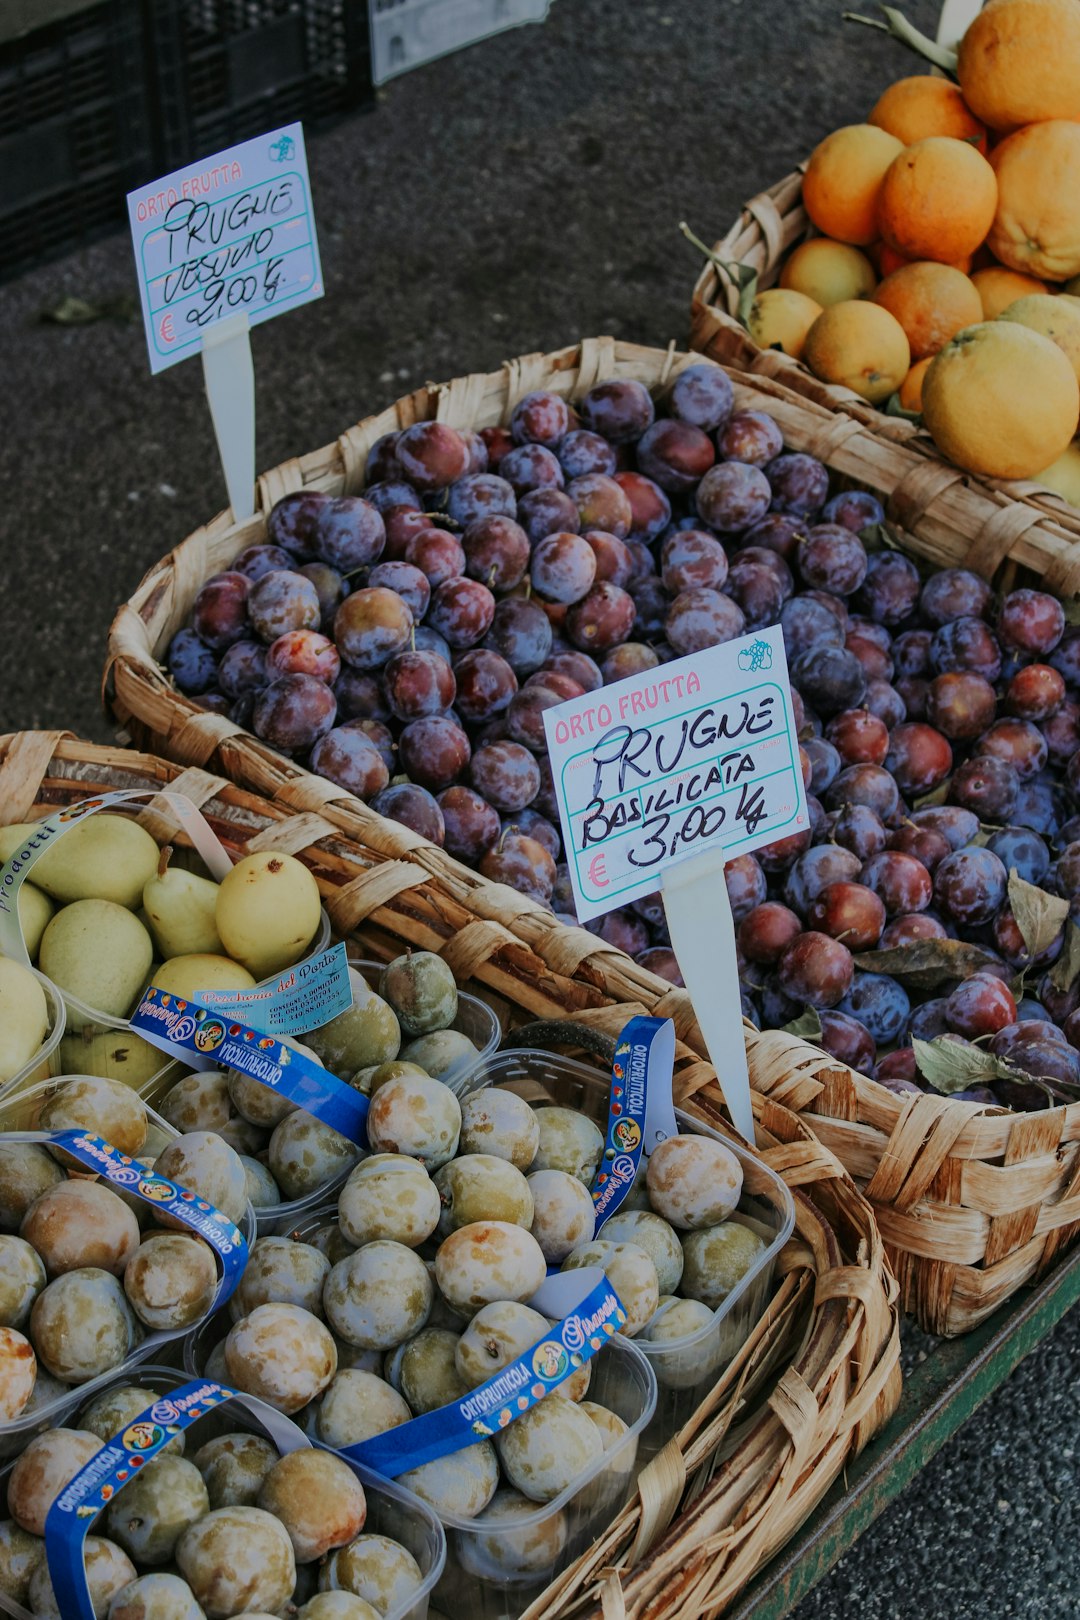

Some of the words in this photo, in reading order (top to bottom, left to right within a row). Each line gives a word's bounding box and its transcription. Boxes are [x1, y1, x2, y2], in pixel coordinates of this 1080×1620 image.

[137, 188, 177, 222] ORTO
[181, 161, 242, 200] FRUTTA
[164, 227, 274, 304] VESUVIO
[160, 314, 176, 343] €
[186, 276, 257, 327] 2,00
[555, 704, 613, 745] ORTO
[618, 671, 701, 720] FRUTTA
[593, 697, 774, 798] PRUGNE
[582, 753, 755, 848] BASILICATA
[588, 853, 610, 888] €
[627, 806, 726, 867] 3,00
[202, 990, 273, 1004] Pescheria
[277, 973, 296, 993] del
[269, 997, 301, 1013] CONSEGNE
[309, 974, 340, 997] DOMICILIO
[218, 1042, 283, 1085] ORTOFRUTTICOLA
[629, 1044, 648, 1115] ORTOFRUTTICOLA
[168, 1200, 233, 1254] ORTOFRUTTICOLA
[459, 1362, 532, 1421] ORTOFRUTTICOLA
[57, 1446, 125, 1512] ORTOFRUTTICOLA
